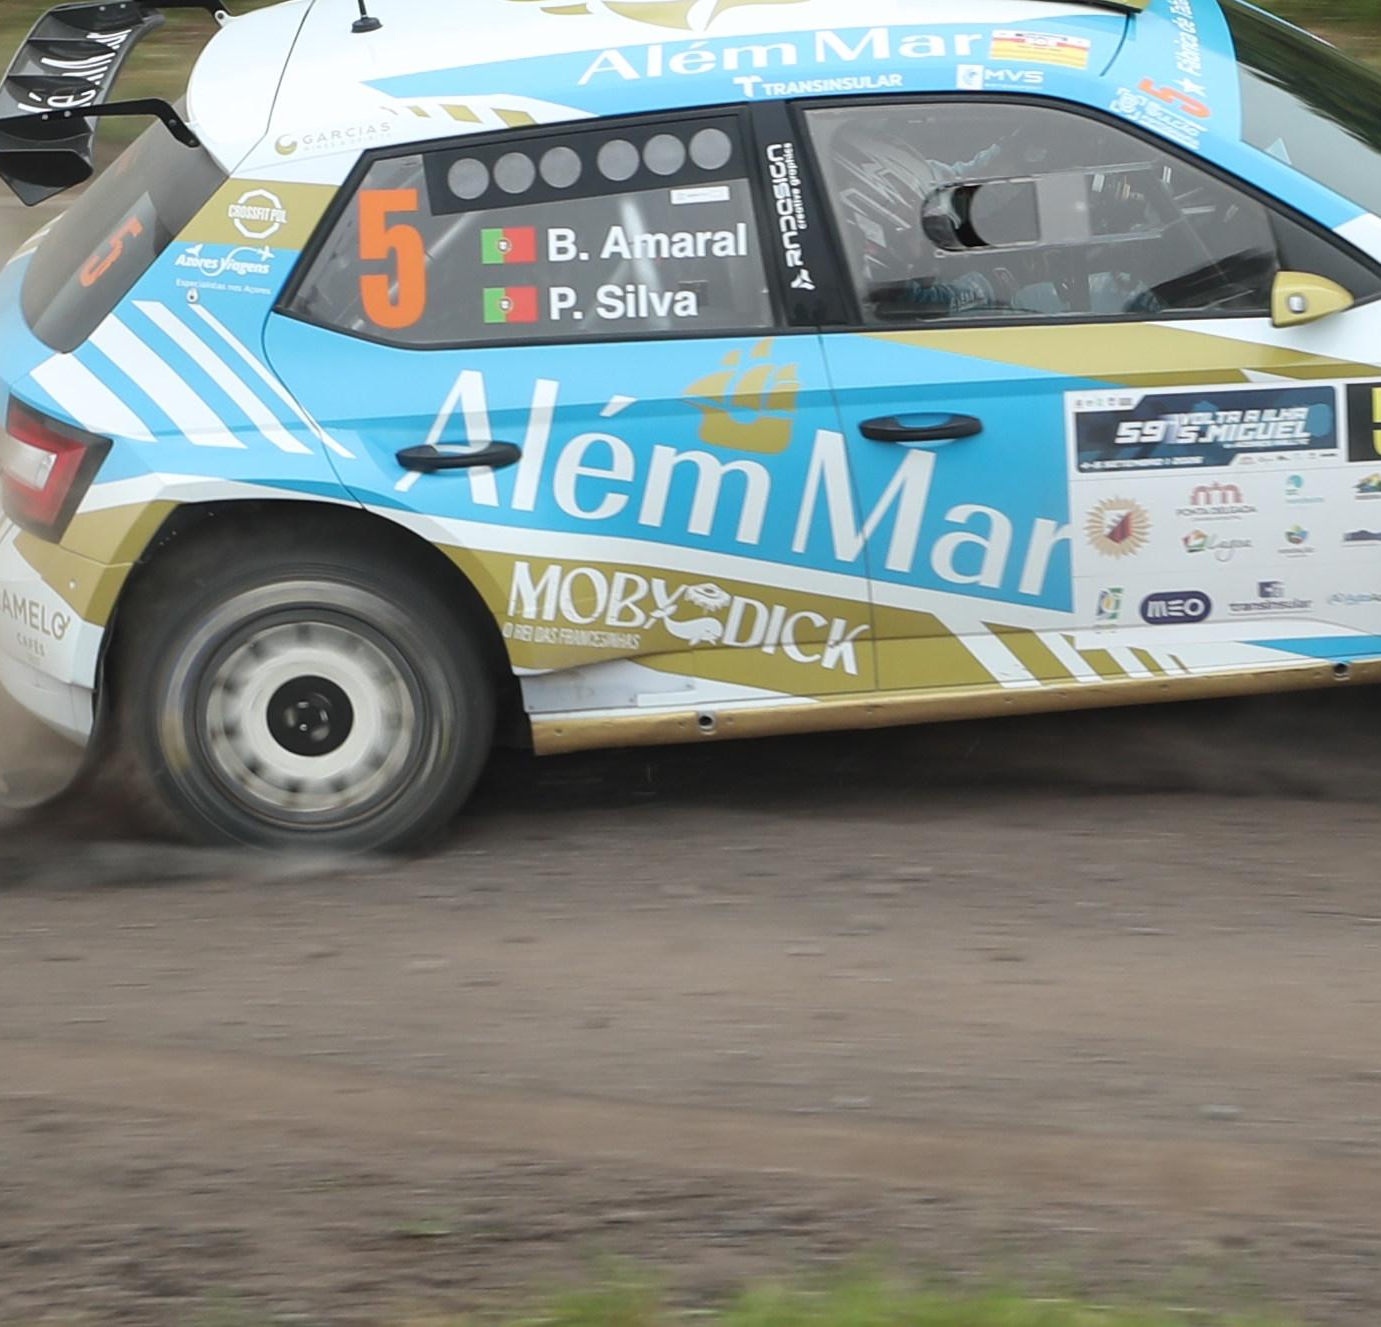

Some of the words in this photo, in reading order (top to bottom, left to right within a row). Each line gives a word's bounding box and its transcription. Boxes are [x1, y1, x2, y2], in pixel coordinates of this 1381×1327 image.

[578, 39, 797, 86] Além
[815, 26, 984, 63] Mar
[984, 68, 1045, 84] MVS
[761, 73, 903, 97] TRANSINSULAR
[302, 121, 391, 145] GARCIAS
[782, 142, 802, 187] graphics
[791, 187, 808, 230] creative
[358, 187, 427, 330] 5
[546, 227, 590, 263] B.
[600, 222, 747, 260] Amaral
[547, 286, 584, 321] P.
[595, 282, 699, 319] Silva
[1113, 419, 1167, 445] 59
[393, 369, 773, 545] Além
[790, 428, 1074, 597] Mar
[507, 561, 688, 630] MOBY
[721, 595, 871, 676] DICK
[1146, 598, 1206, 619] MEO
